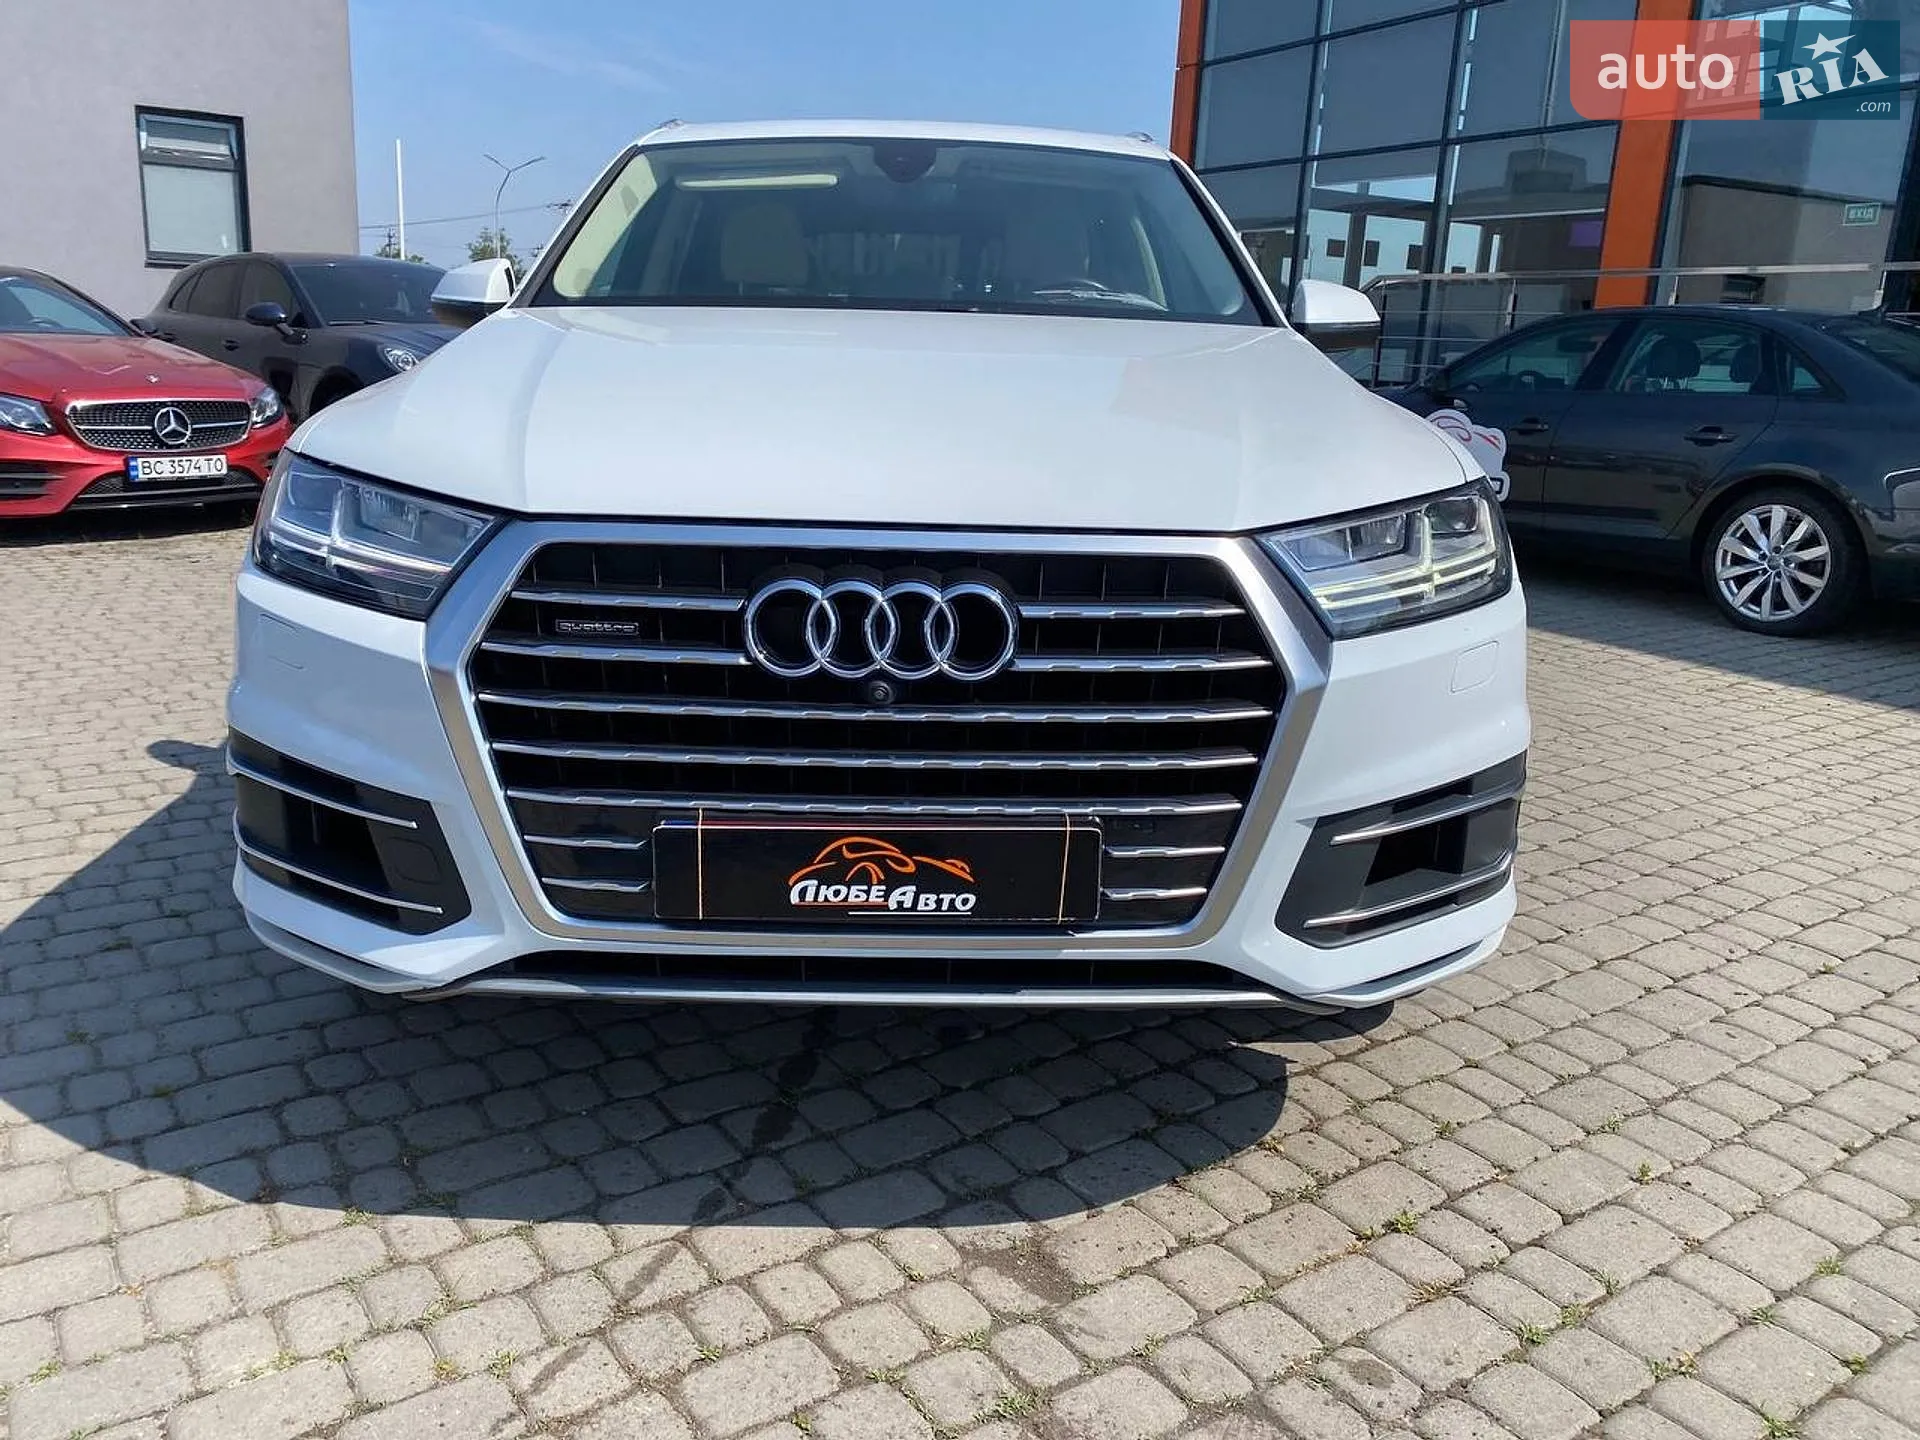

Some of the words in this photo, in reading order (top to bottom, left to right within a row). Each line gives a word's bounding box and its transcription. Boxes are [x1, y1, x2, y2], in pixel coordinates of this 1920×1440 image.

[141, 460, 164, 476] BC
[169, 458, 201, 475] 3574
[559, 622, 635, 634] quattro
